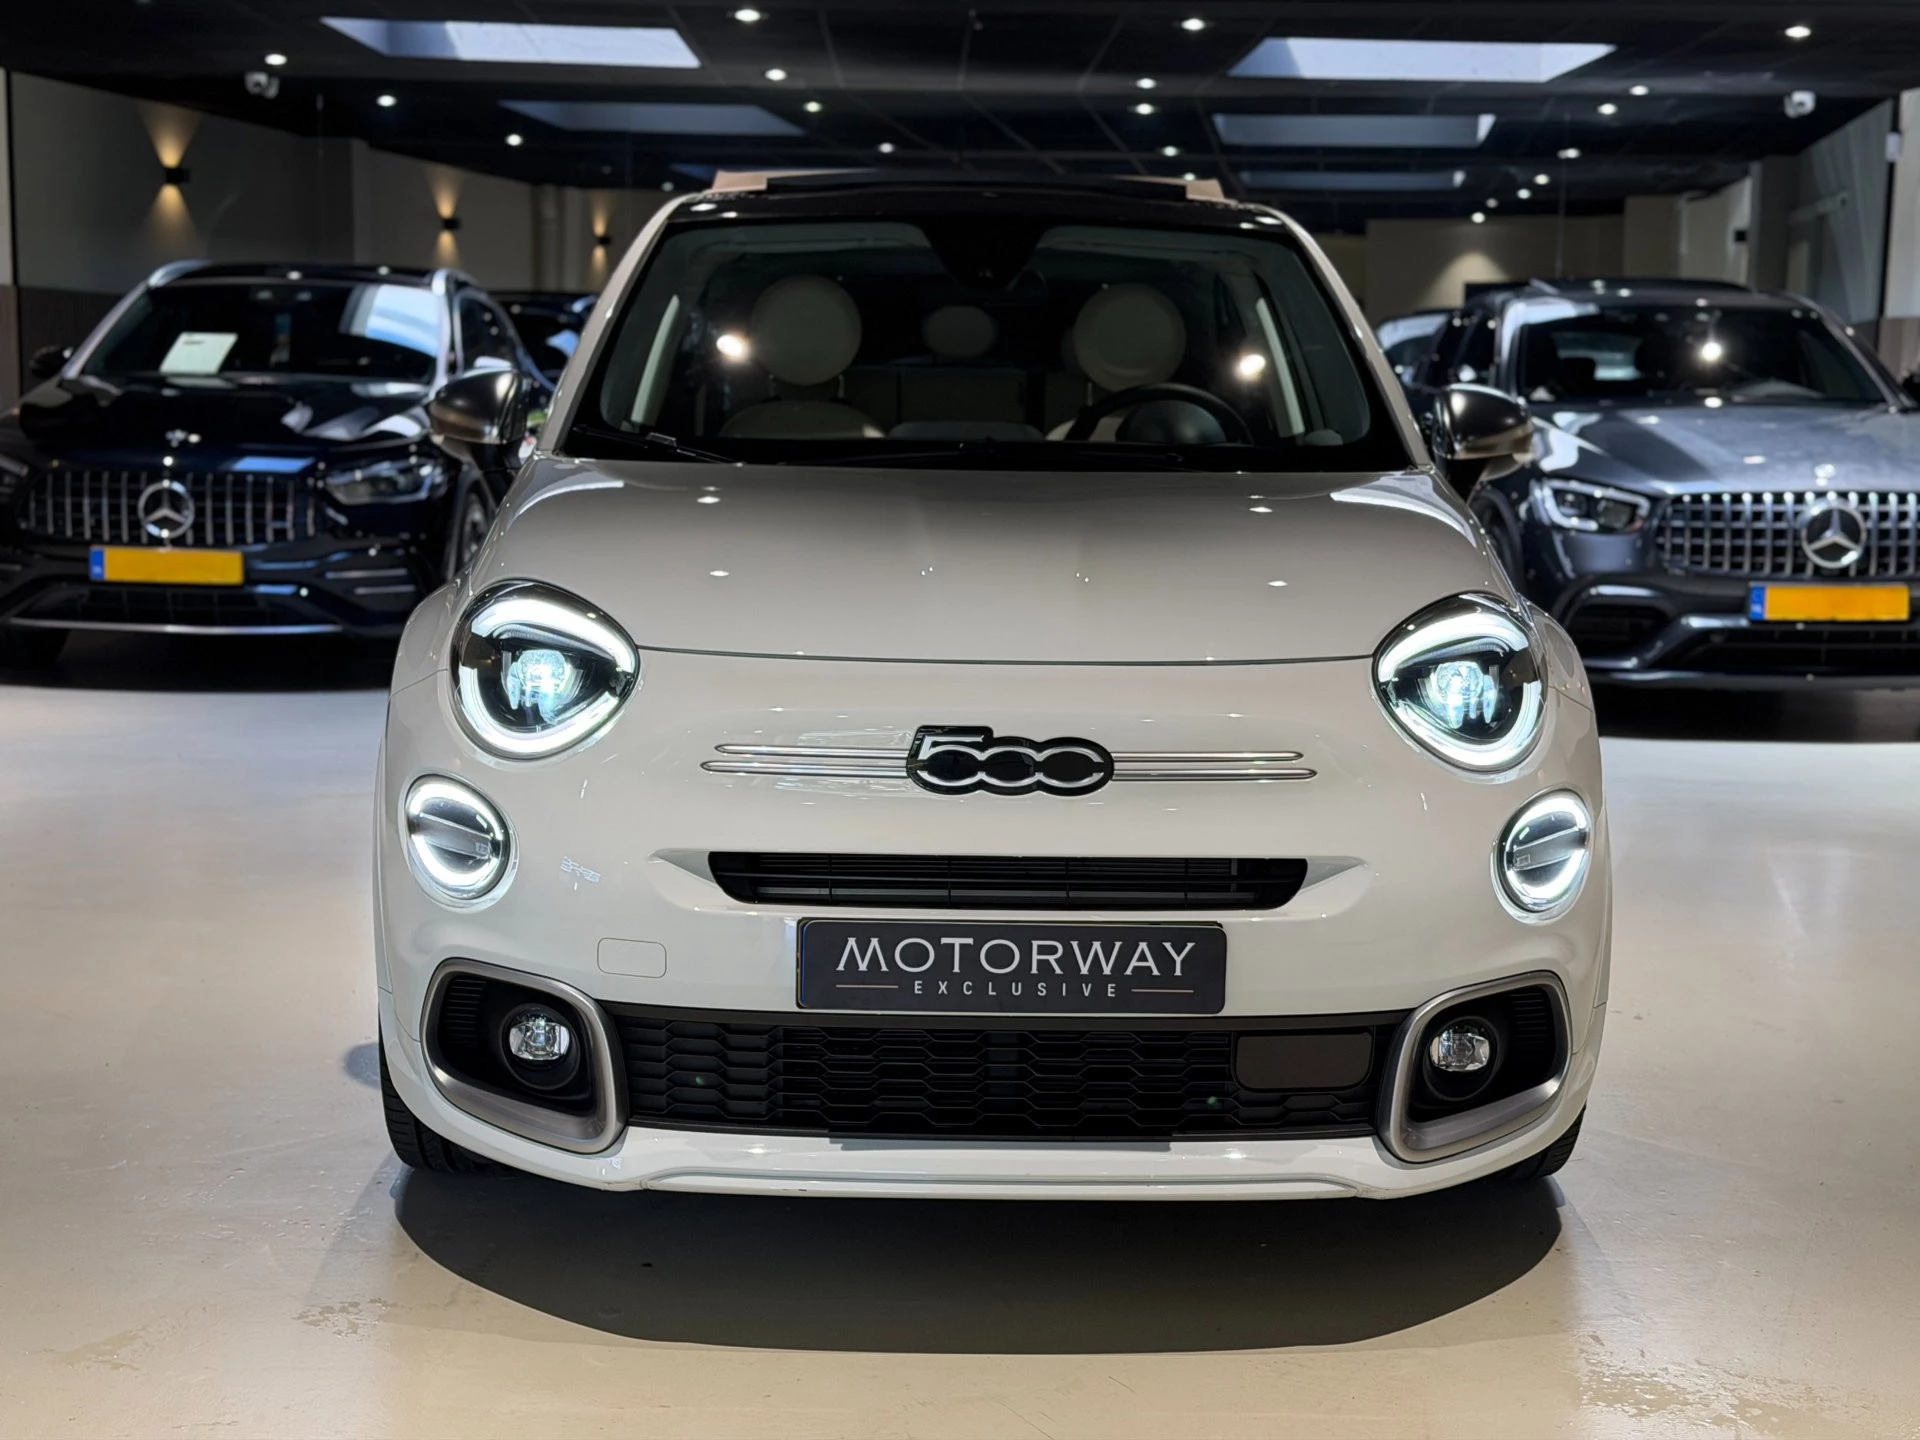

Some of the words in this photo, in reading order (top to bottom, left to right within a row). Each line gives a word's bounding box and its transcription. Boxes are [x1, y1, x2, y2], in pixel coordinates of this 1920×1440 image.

[914, 731, 1107, 791] 500
[834, 936, 1197, 976] MOTORWAY
[914, 980, 1117, 998] EXCLUSIVE
